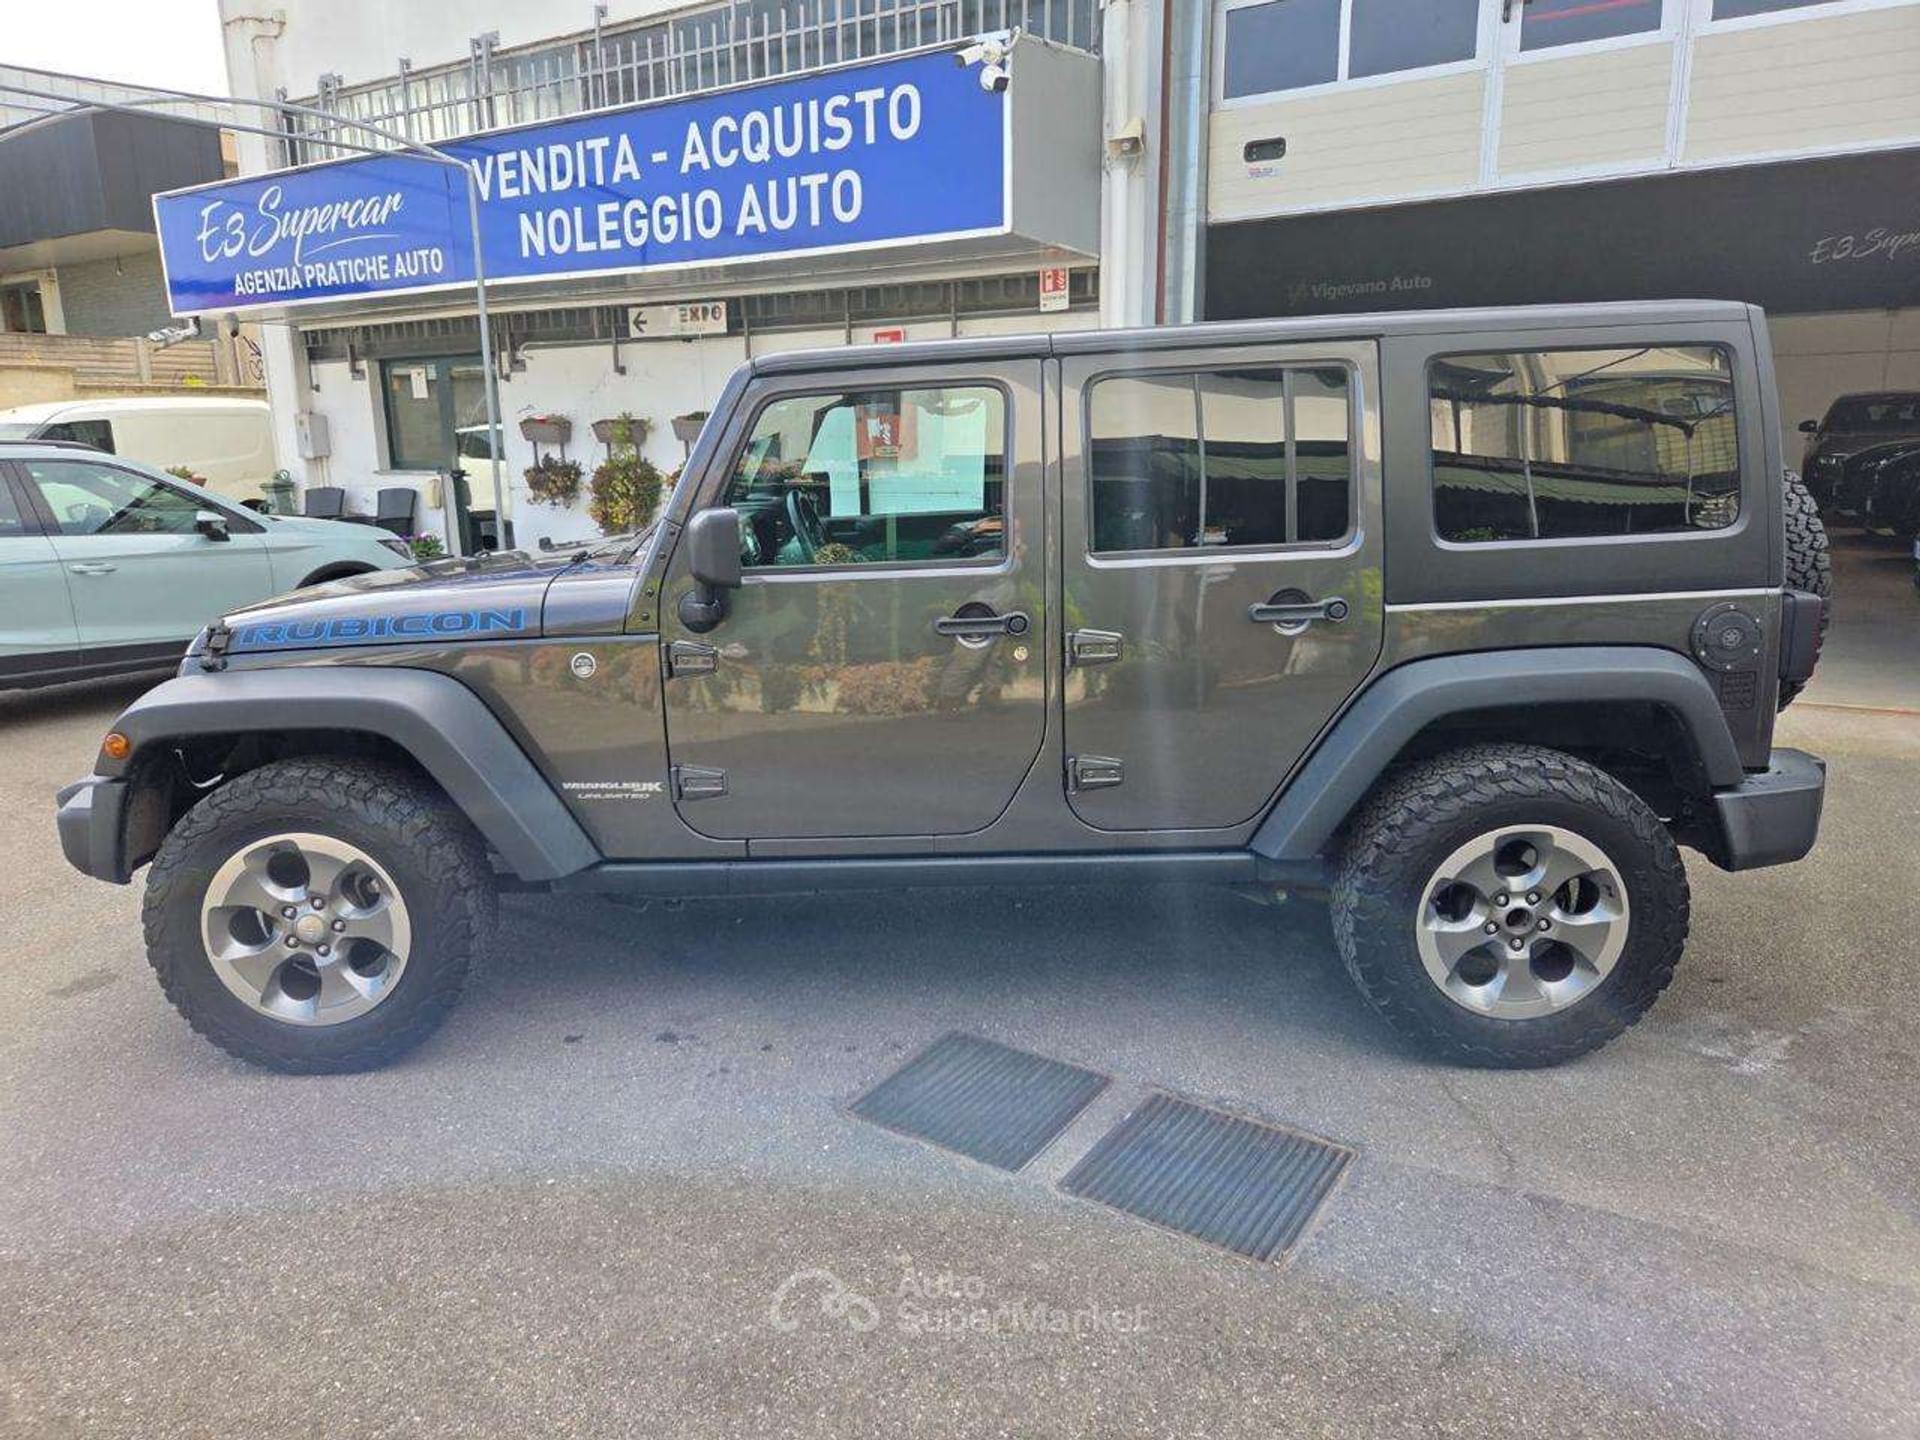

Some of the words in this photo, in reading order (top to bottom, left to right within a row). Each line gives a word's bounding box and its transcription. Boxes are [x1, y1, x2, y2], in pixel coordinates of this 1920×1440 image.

[472, 133, 641, 201] VENDITA
[651, 150, 668, 164] -
[680, 83, 922, 174] ACQUISTO
[197, 200, 246, 263] E3
[248, 185, 404, 267] Supercar
[519, 188, 722, 258] NOLEGGIO
[736, 169, 863, 236] AUTO
[234, 267, 303, 296] AGENZIA
[306, 255, 390, 288] PRATICHE
[394, 247, 443, 275] AUTO
[1809, 236, 1855, 264] E3
[1310, 280, 1387, 301] Vigevano
[1389, 275, 1433, 292] Auto
[678, 303, 722, 323] EXPO
[240, 607, 526, 646] RUBICON
